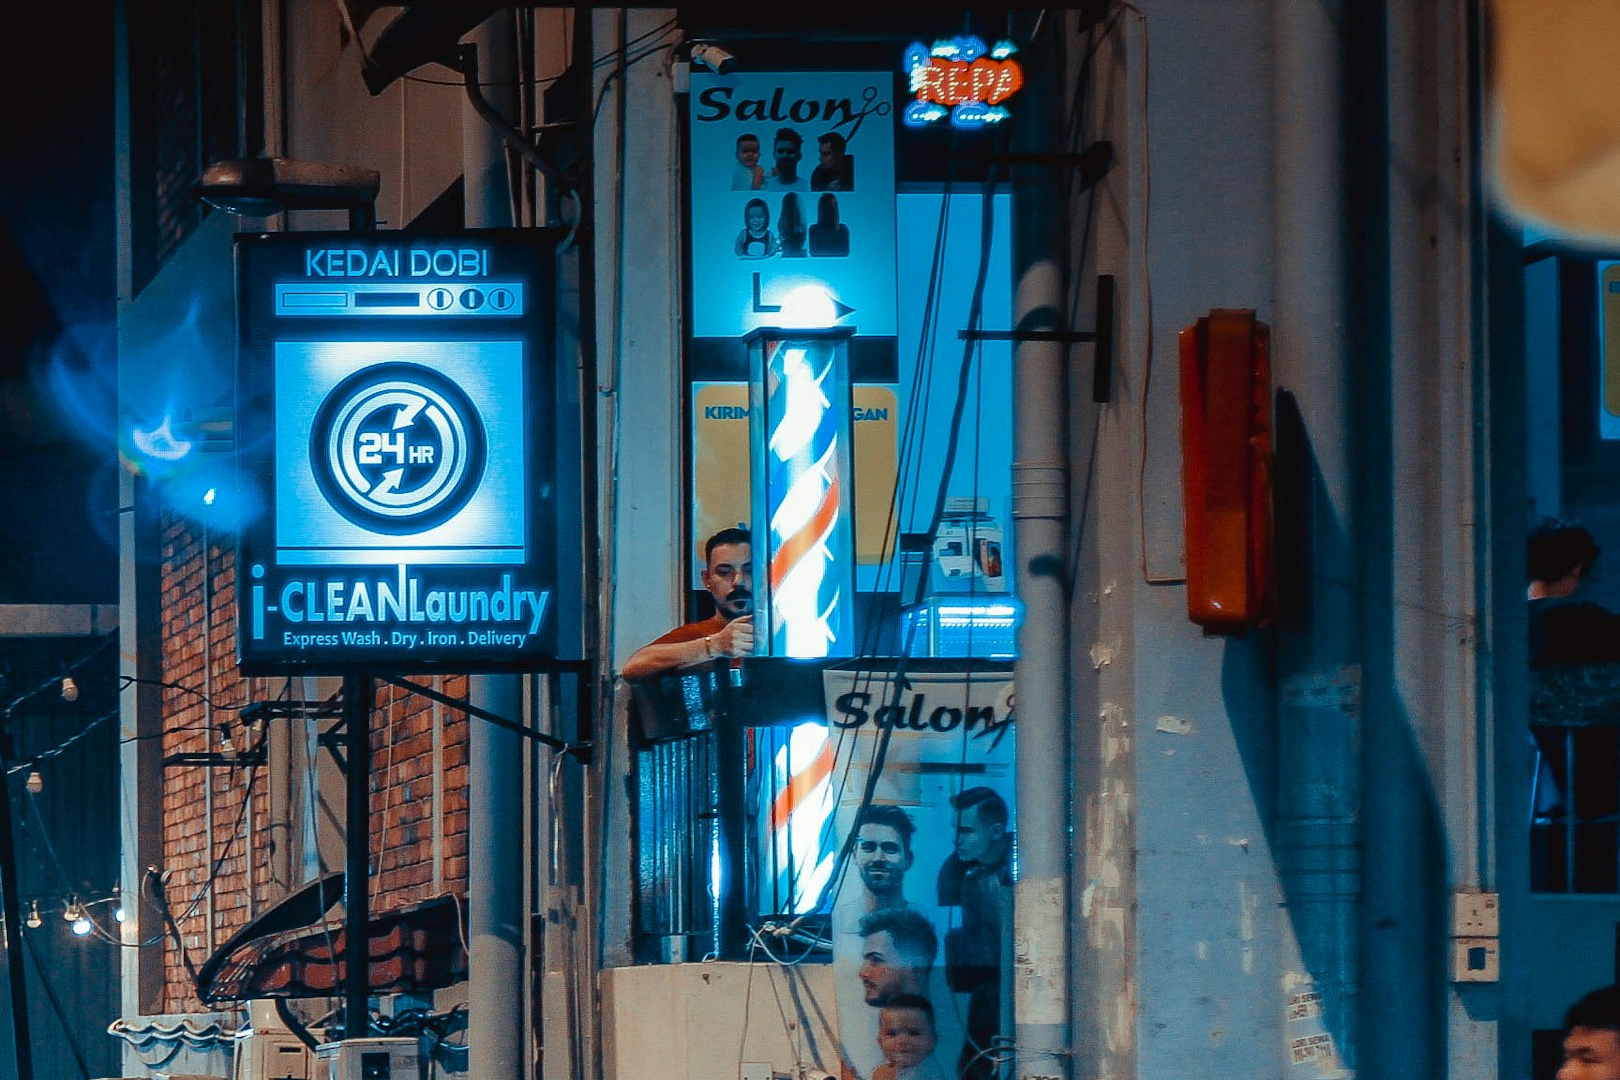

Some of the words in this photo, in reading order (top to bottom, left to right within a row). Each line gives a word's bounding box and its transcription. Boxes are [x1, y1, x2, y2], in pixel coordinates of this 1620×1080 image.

[696, 86, 856, 123] Salon
[306, 249, 400, 277] KEDAI
[410, 249, 488, 277] DOBI
[358, 431, 405, 465] 24
[409, 446, 434, 465] HR
[283, 631, 340, 648] Express
[468, 631, 526, 648] Delivery
[833, 692, 995, 732] Salon
